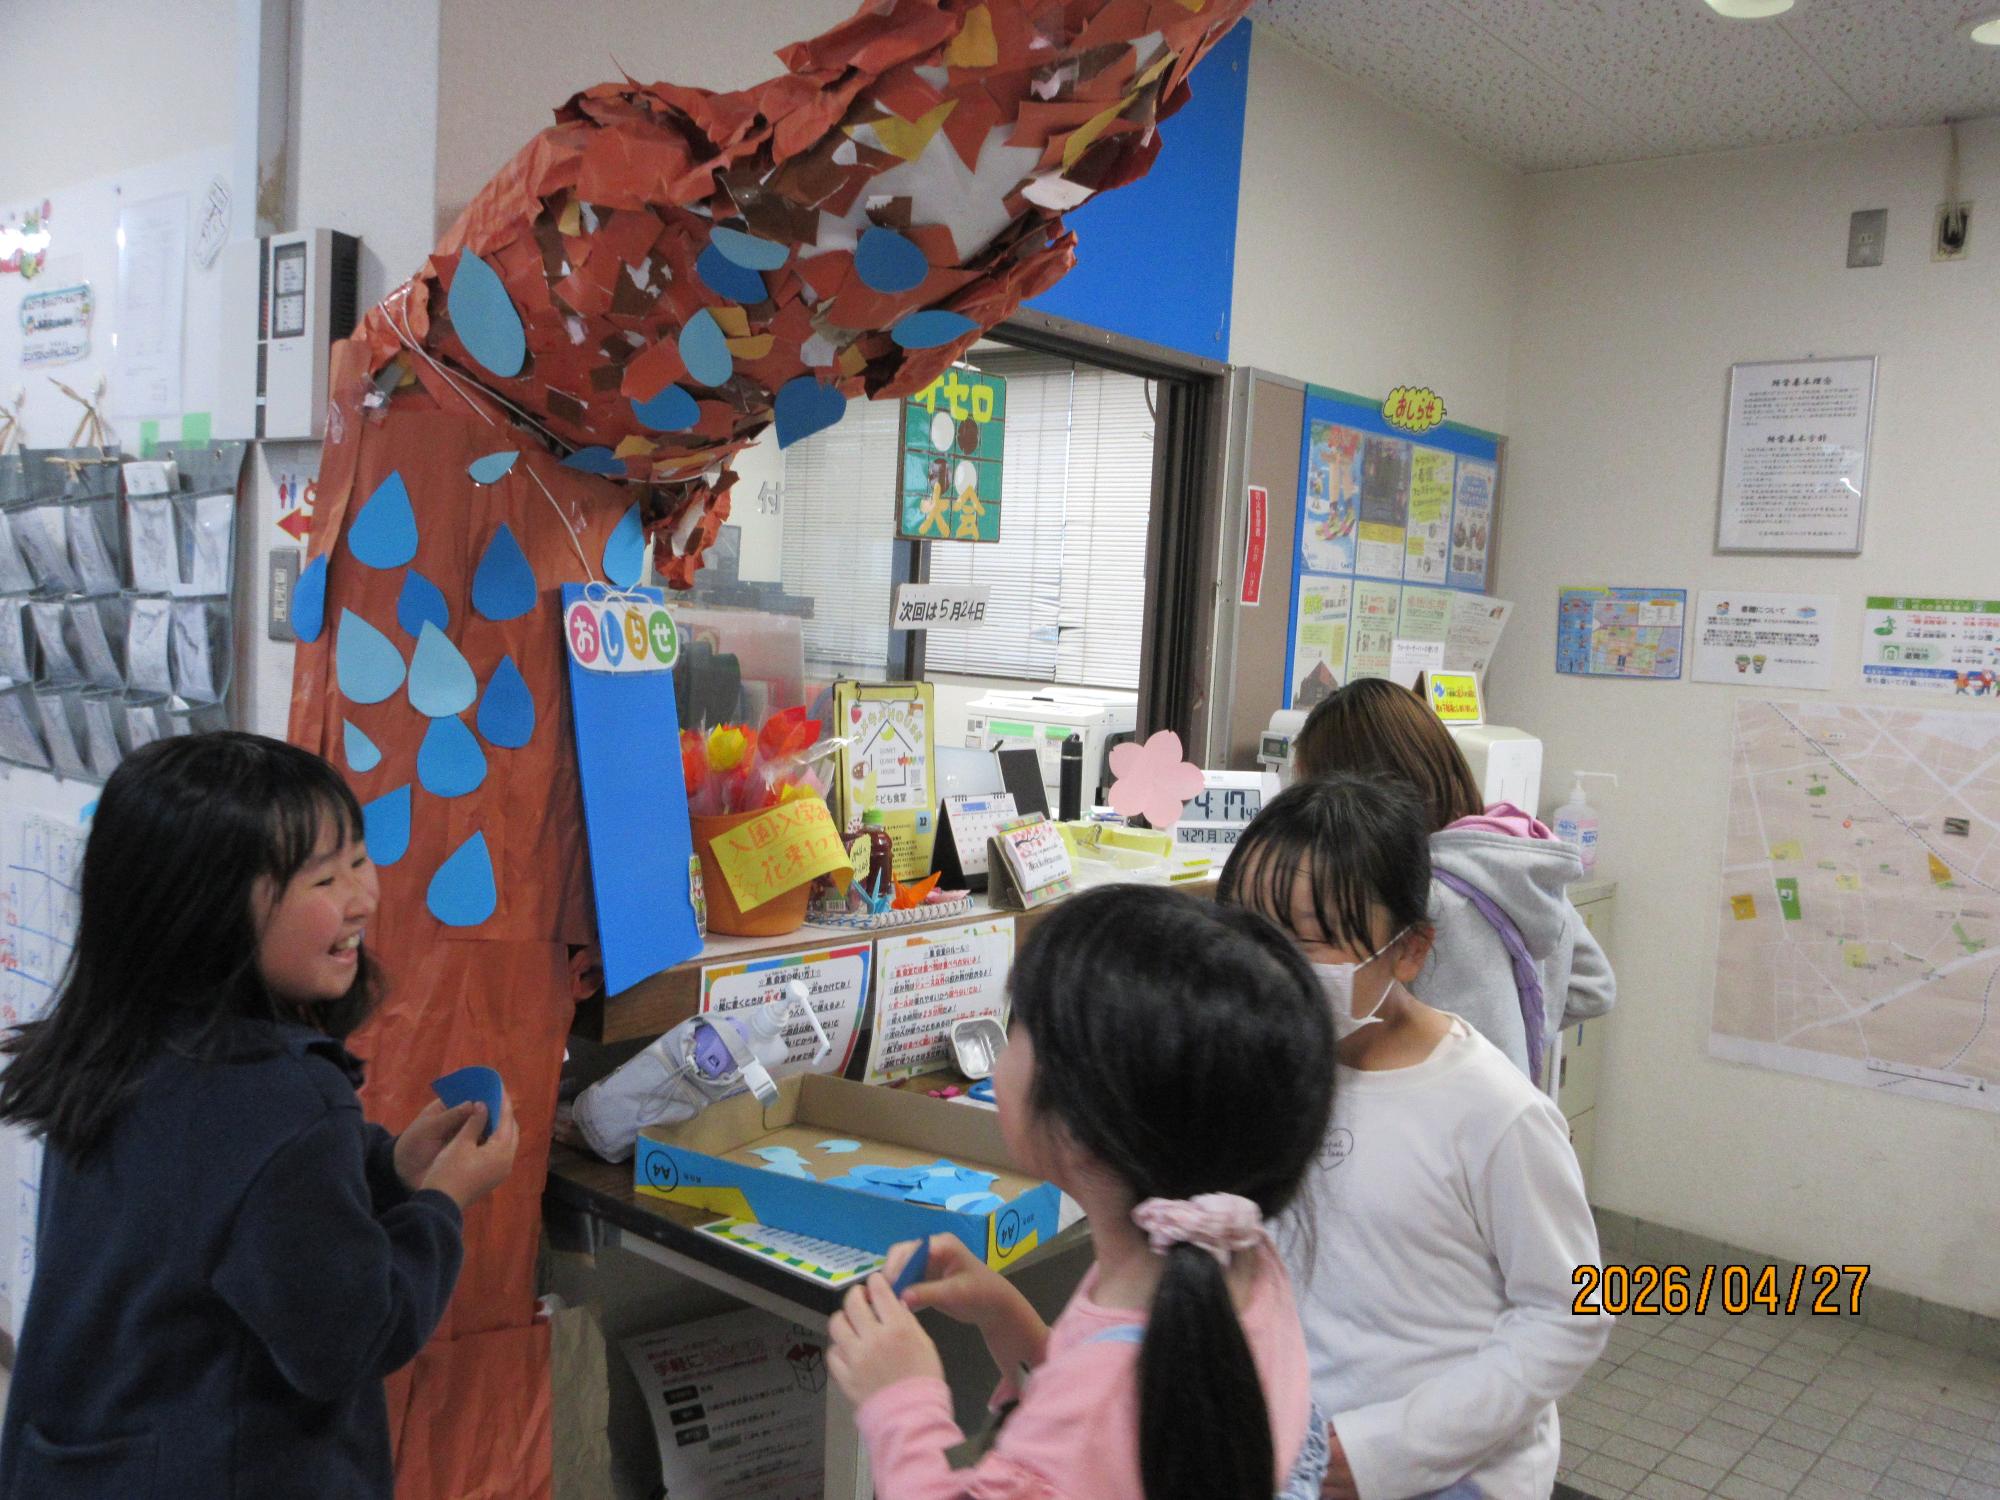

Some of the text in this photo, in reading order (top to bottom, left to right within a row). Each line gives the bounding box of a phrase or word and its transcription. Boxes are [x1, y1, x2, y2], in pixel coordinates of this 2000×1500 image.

[1396, 392, 1435, 420] おしらせ
[919, 482, 985, 541] 大会
[899, 599, 985, 622] 次回は5月24日
[574, 614, 672, 657] おしらせ
[653, 1163, 672, 1180] A4
[1001, 1223, 1015, 1244] A4
